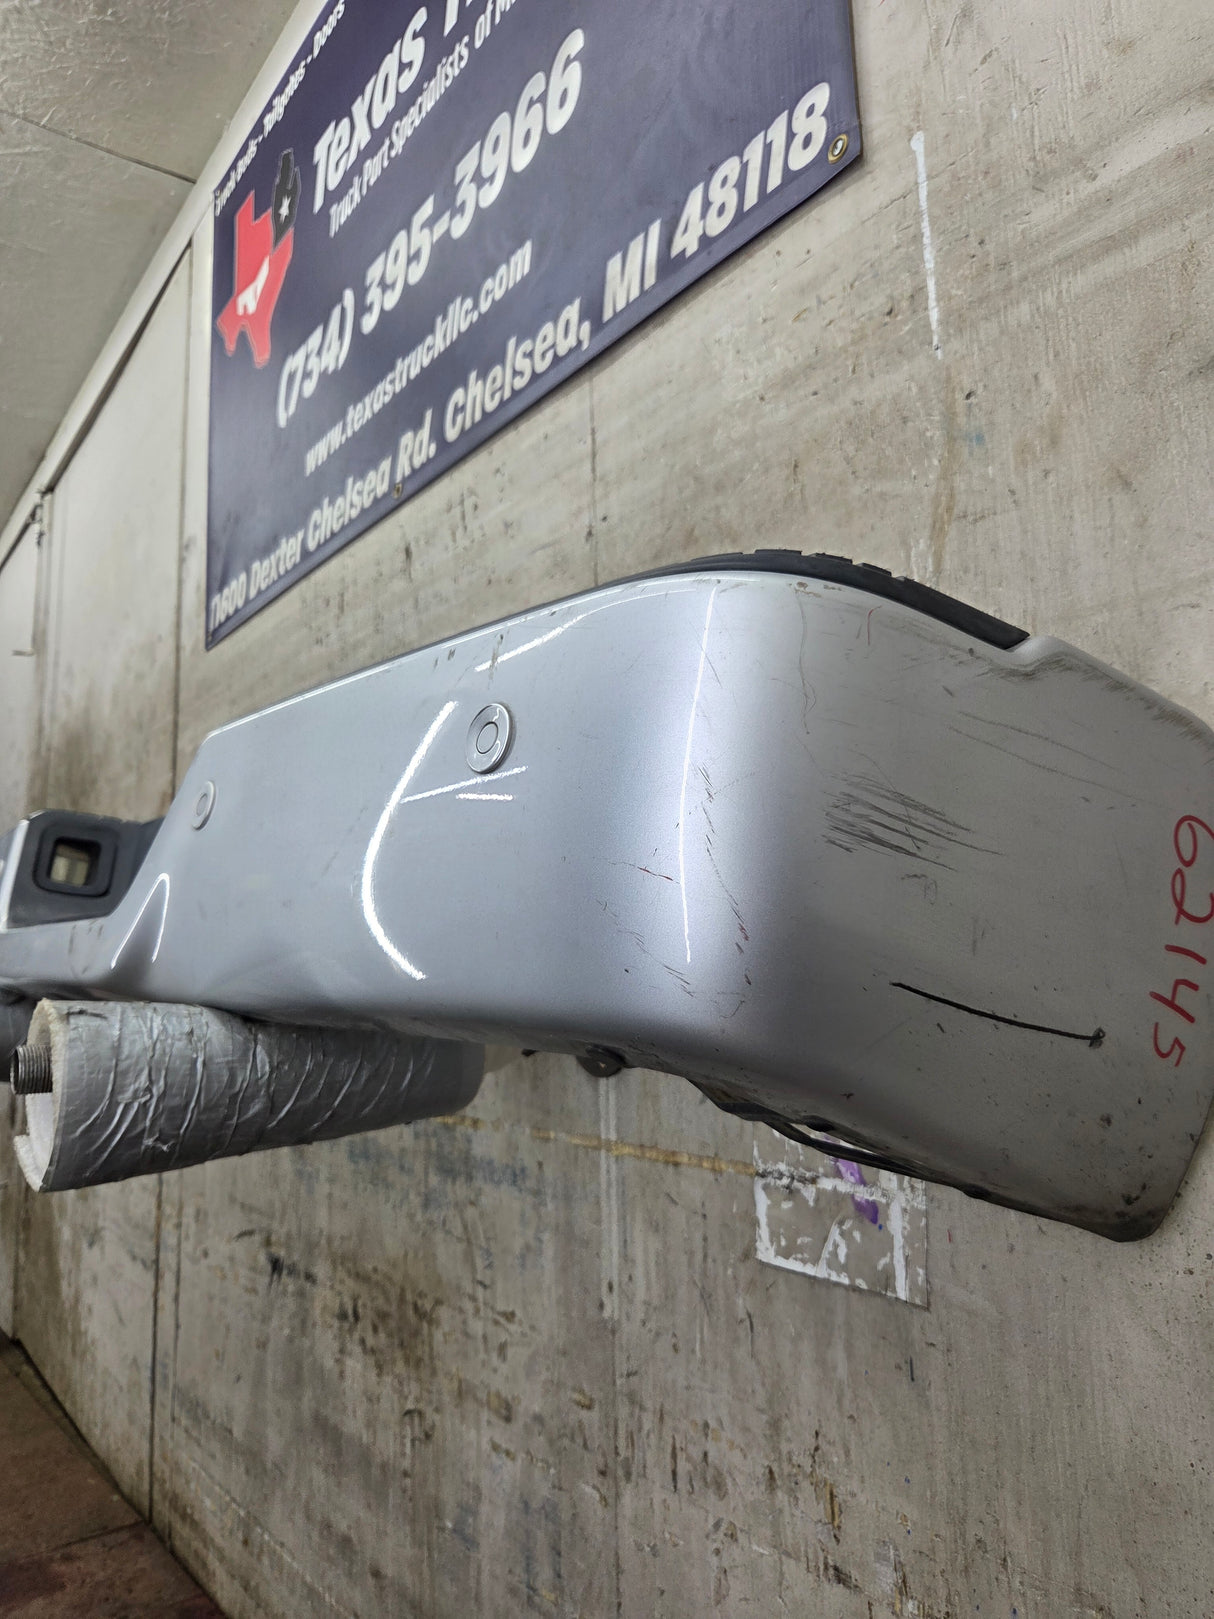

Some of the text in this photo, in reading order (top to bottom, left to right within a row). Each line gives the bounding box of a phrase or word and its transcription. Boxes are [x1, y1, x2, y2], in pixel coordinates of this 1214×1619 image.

[263, 60, 305, 137] Tailgates
[313, 0, 345, 58] Doors
[313, 6, 427, 214] Texas
[329, 175, 361, 238] Truck
[361, 137, 390, 196] Part
[390, 35, 469, 158] Specialists
[474, 0, 493, 49] of
[249, 528, 305, 600] Dexter
[307, 456, 392, 552] Chelsea
[395, 408, 436, 484] Rd.
[444, 297, 591, 443] Chelsea,
[602, 218, 661, 323] MI
[670, 82, 830, 259] 48118
[276, 29, 585, 428] (734) 395-3966
[305, 240, 532, 476] www.texastruckllc.com
